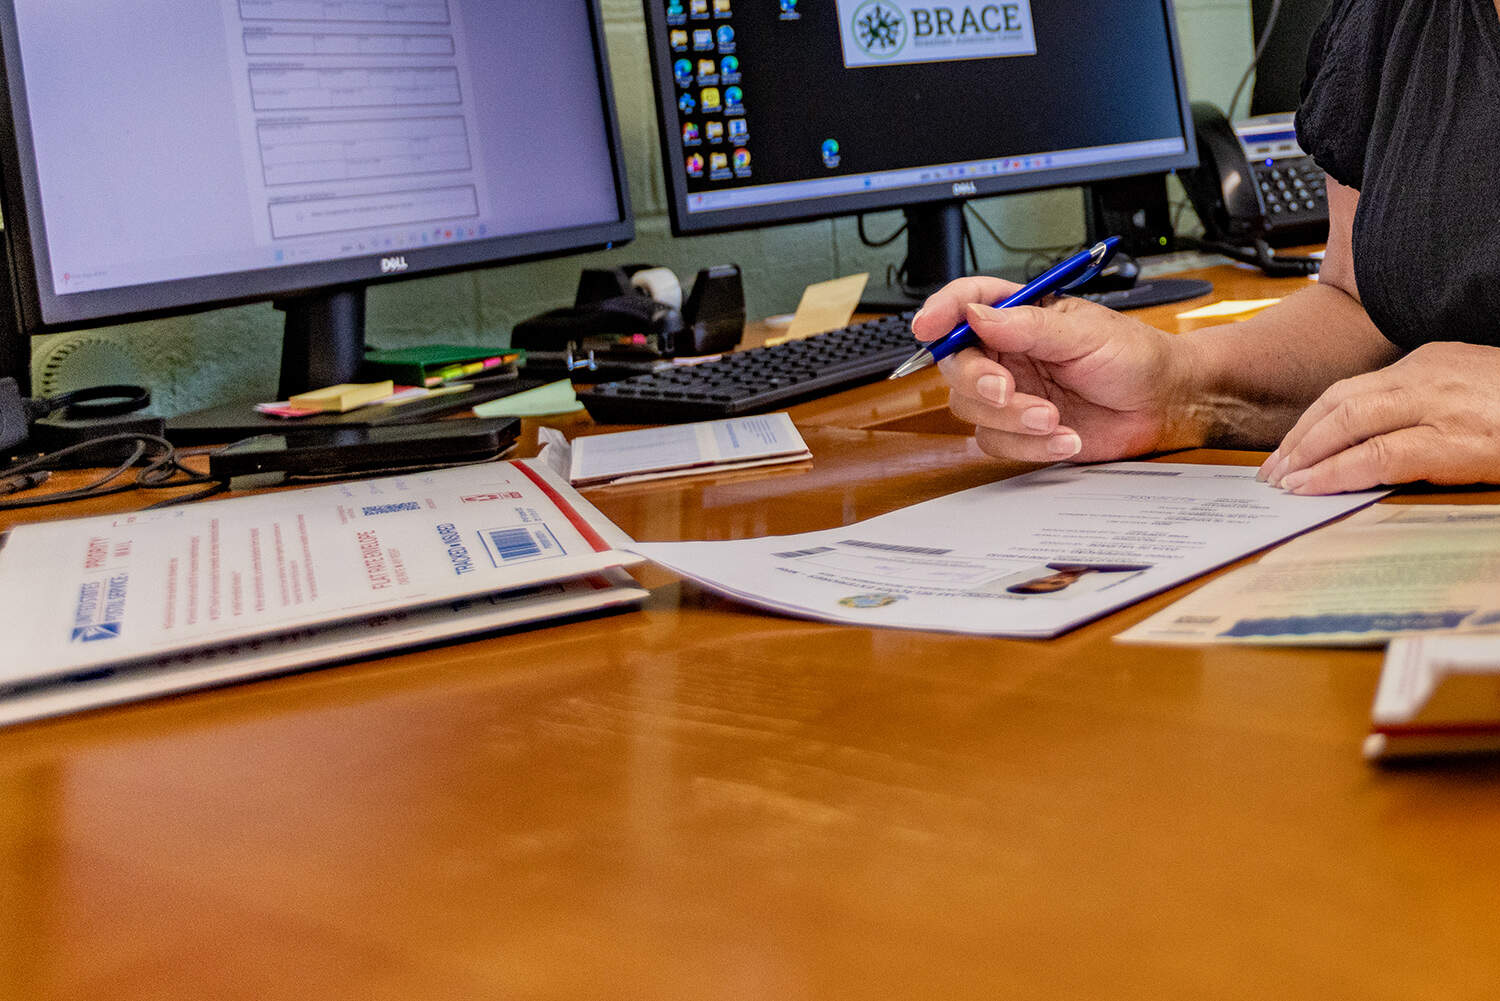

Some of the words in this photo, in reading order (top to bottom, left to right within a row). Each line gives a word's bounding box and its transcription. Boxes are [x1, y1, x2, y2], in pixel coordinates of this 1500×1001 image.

[910, 3, 1022, 38] BRACE
[953, 181, 977, 197] DELL
[381, 256, 408, 273] DELL
[436, 522, 463, 545] INSURED
[84, 537, 109, 569] PRIORITY
[113, 540, 132, 558] MAIL
[356, 530, 386, 558] ENVELOPE
[364, 558, 389, 574] RATE
[447, 546, 476, 576] TRACKED
[369, 573, 393, 590] FLAT
